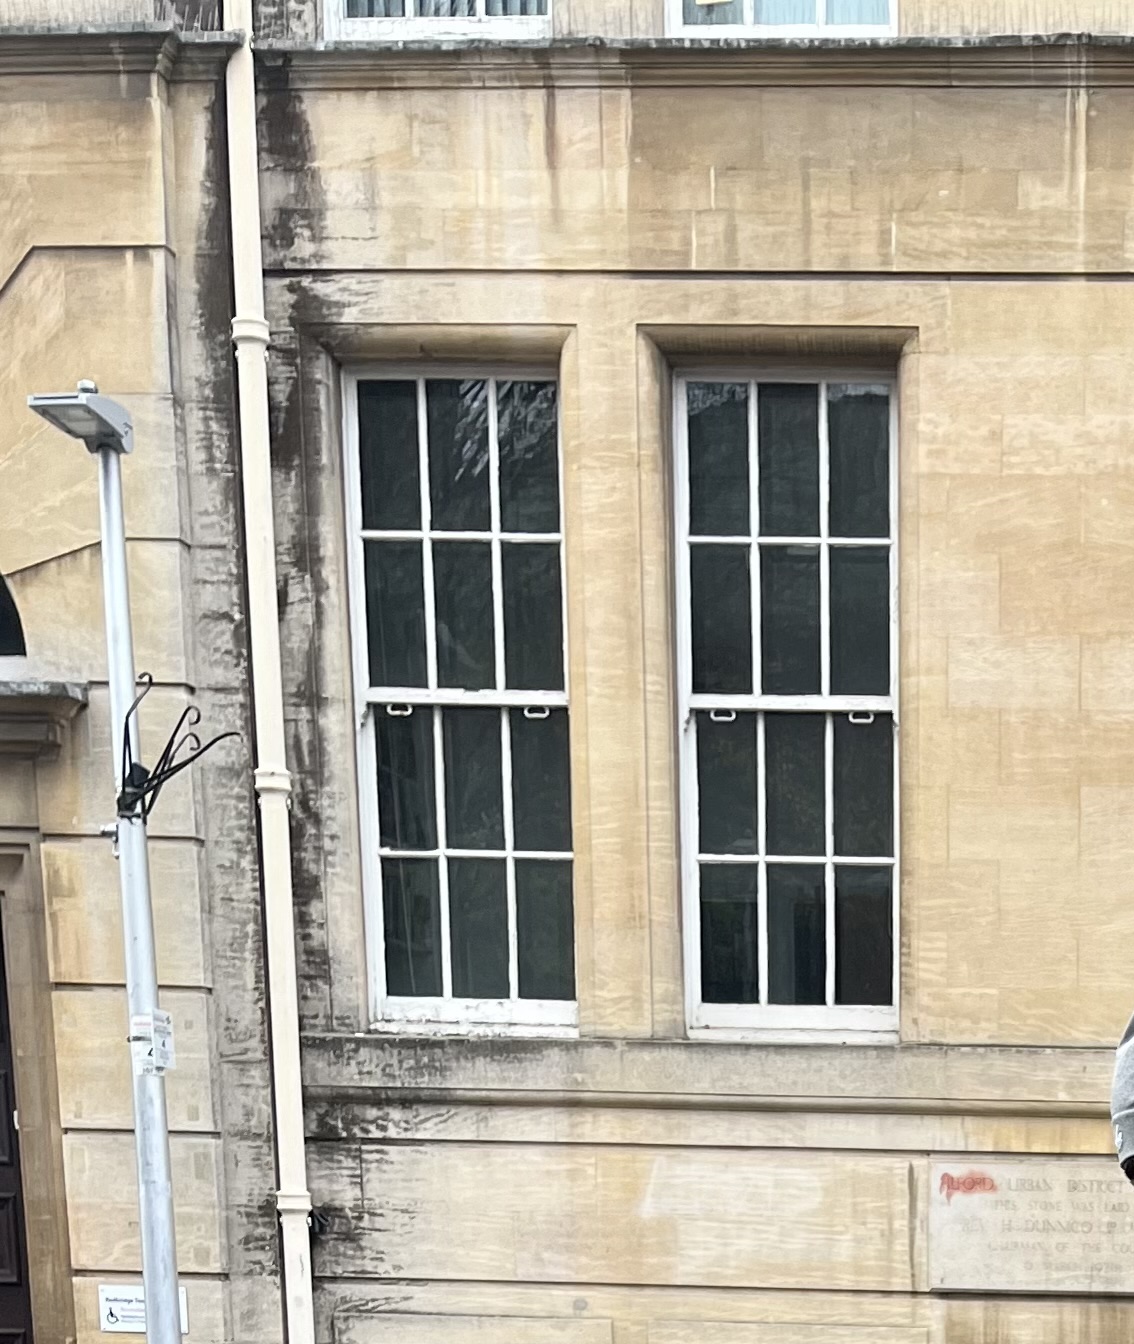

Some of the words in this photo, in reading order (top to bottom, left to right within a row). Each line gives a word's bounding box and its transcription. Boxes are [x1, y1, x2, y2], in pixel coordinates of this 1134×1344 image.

[947, 1177, 994, 1191] ILFORD
[1007, 1178, 1052, 1192] URBAN
[1066, 1179, 1126, 1193] DISTRICT
[1027, 1201, 1062, 1212] STONE
[1070, 1201, 1095, 1213] WAS
[1103, 1202, 1130, 1213] LAID
